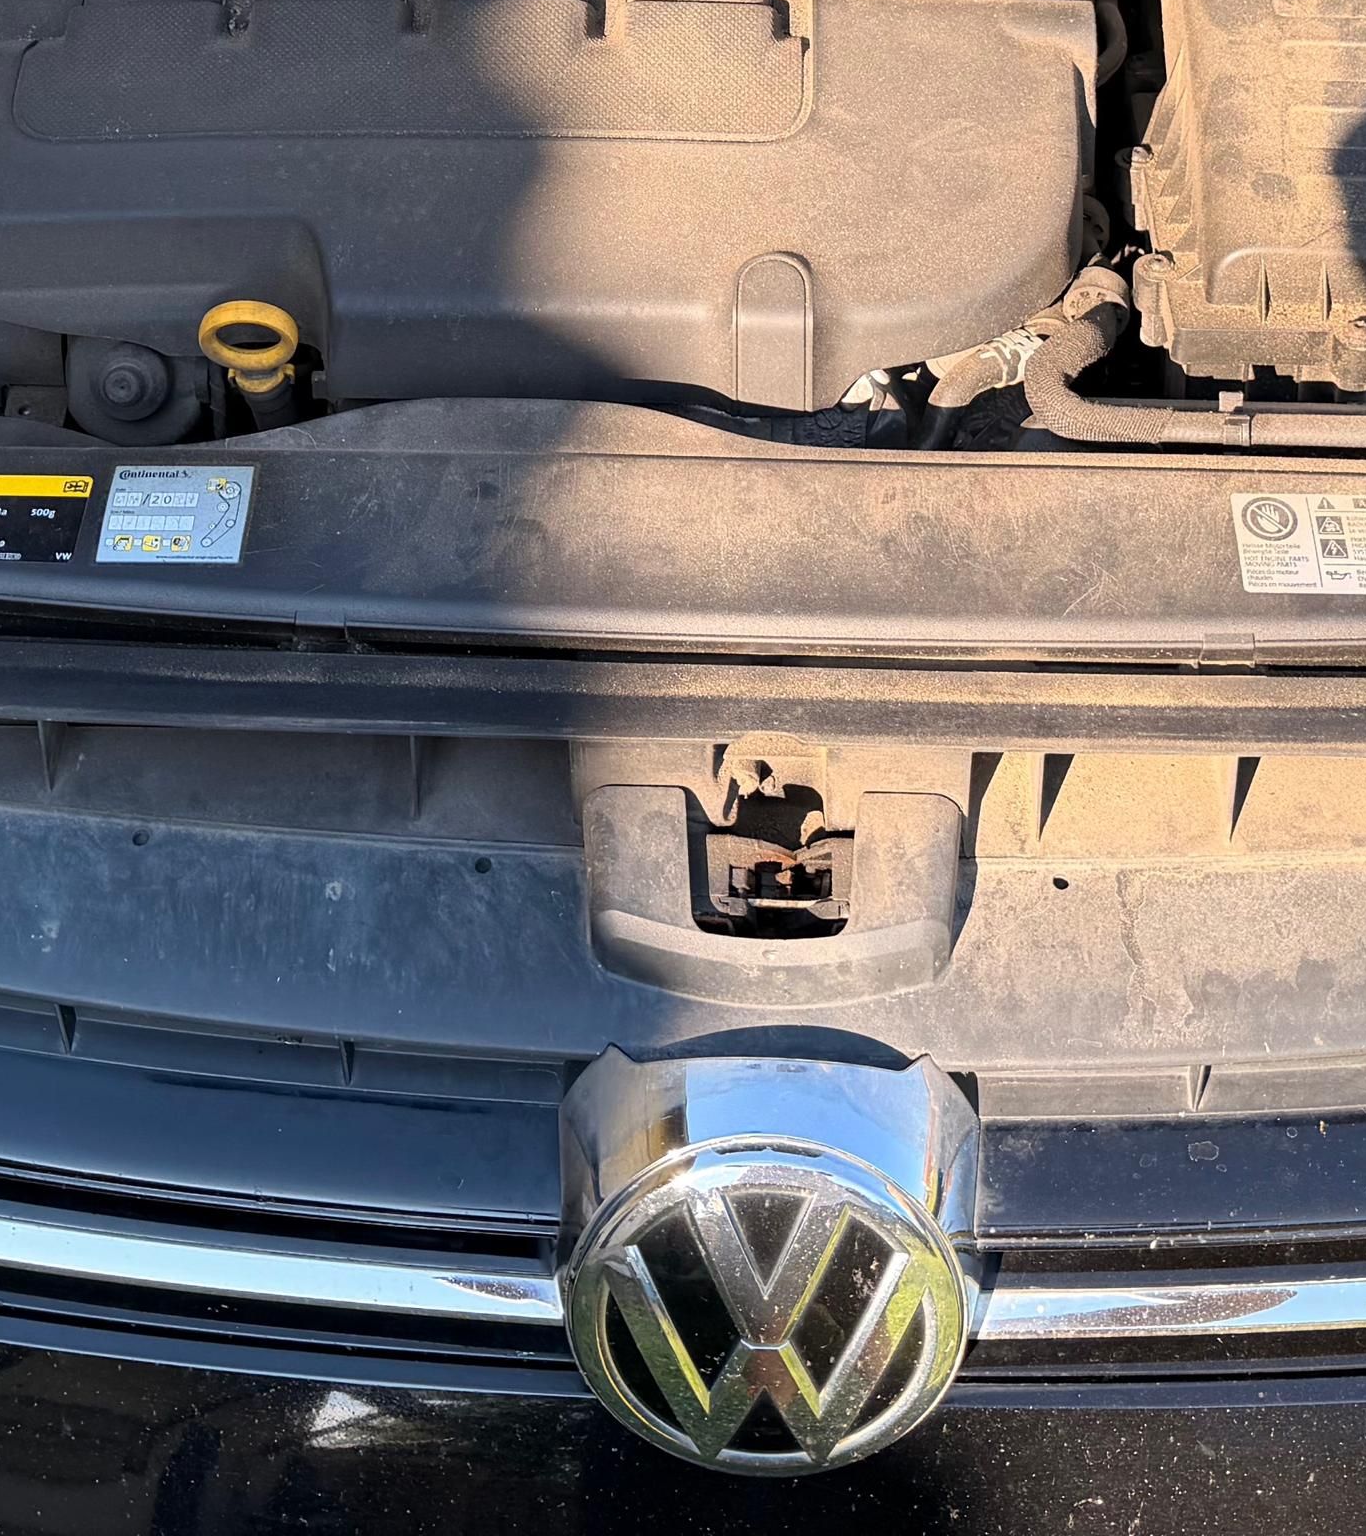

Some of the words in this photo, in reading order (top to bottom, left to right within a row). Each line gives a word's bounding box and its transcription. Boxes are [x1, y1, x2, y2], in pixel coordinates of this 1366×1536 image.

[119, 469, 179, 480] Continental
[30, 508, 56, 519] 500g
[55, 552, 72, 560] VW
[571, 1144, 965, 1474] VW
